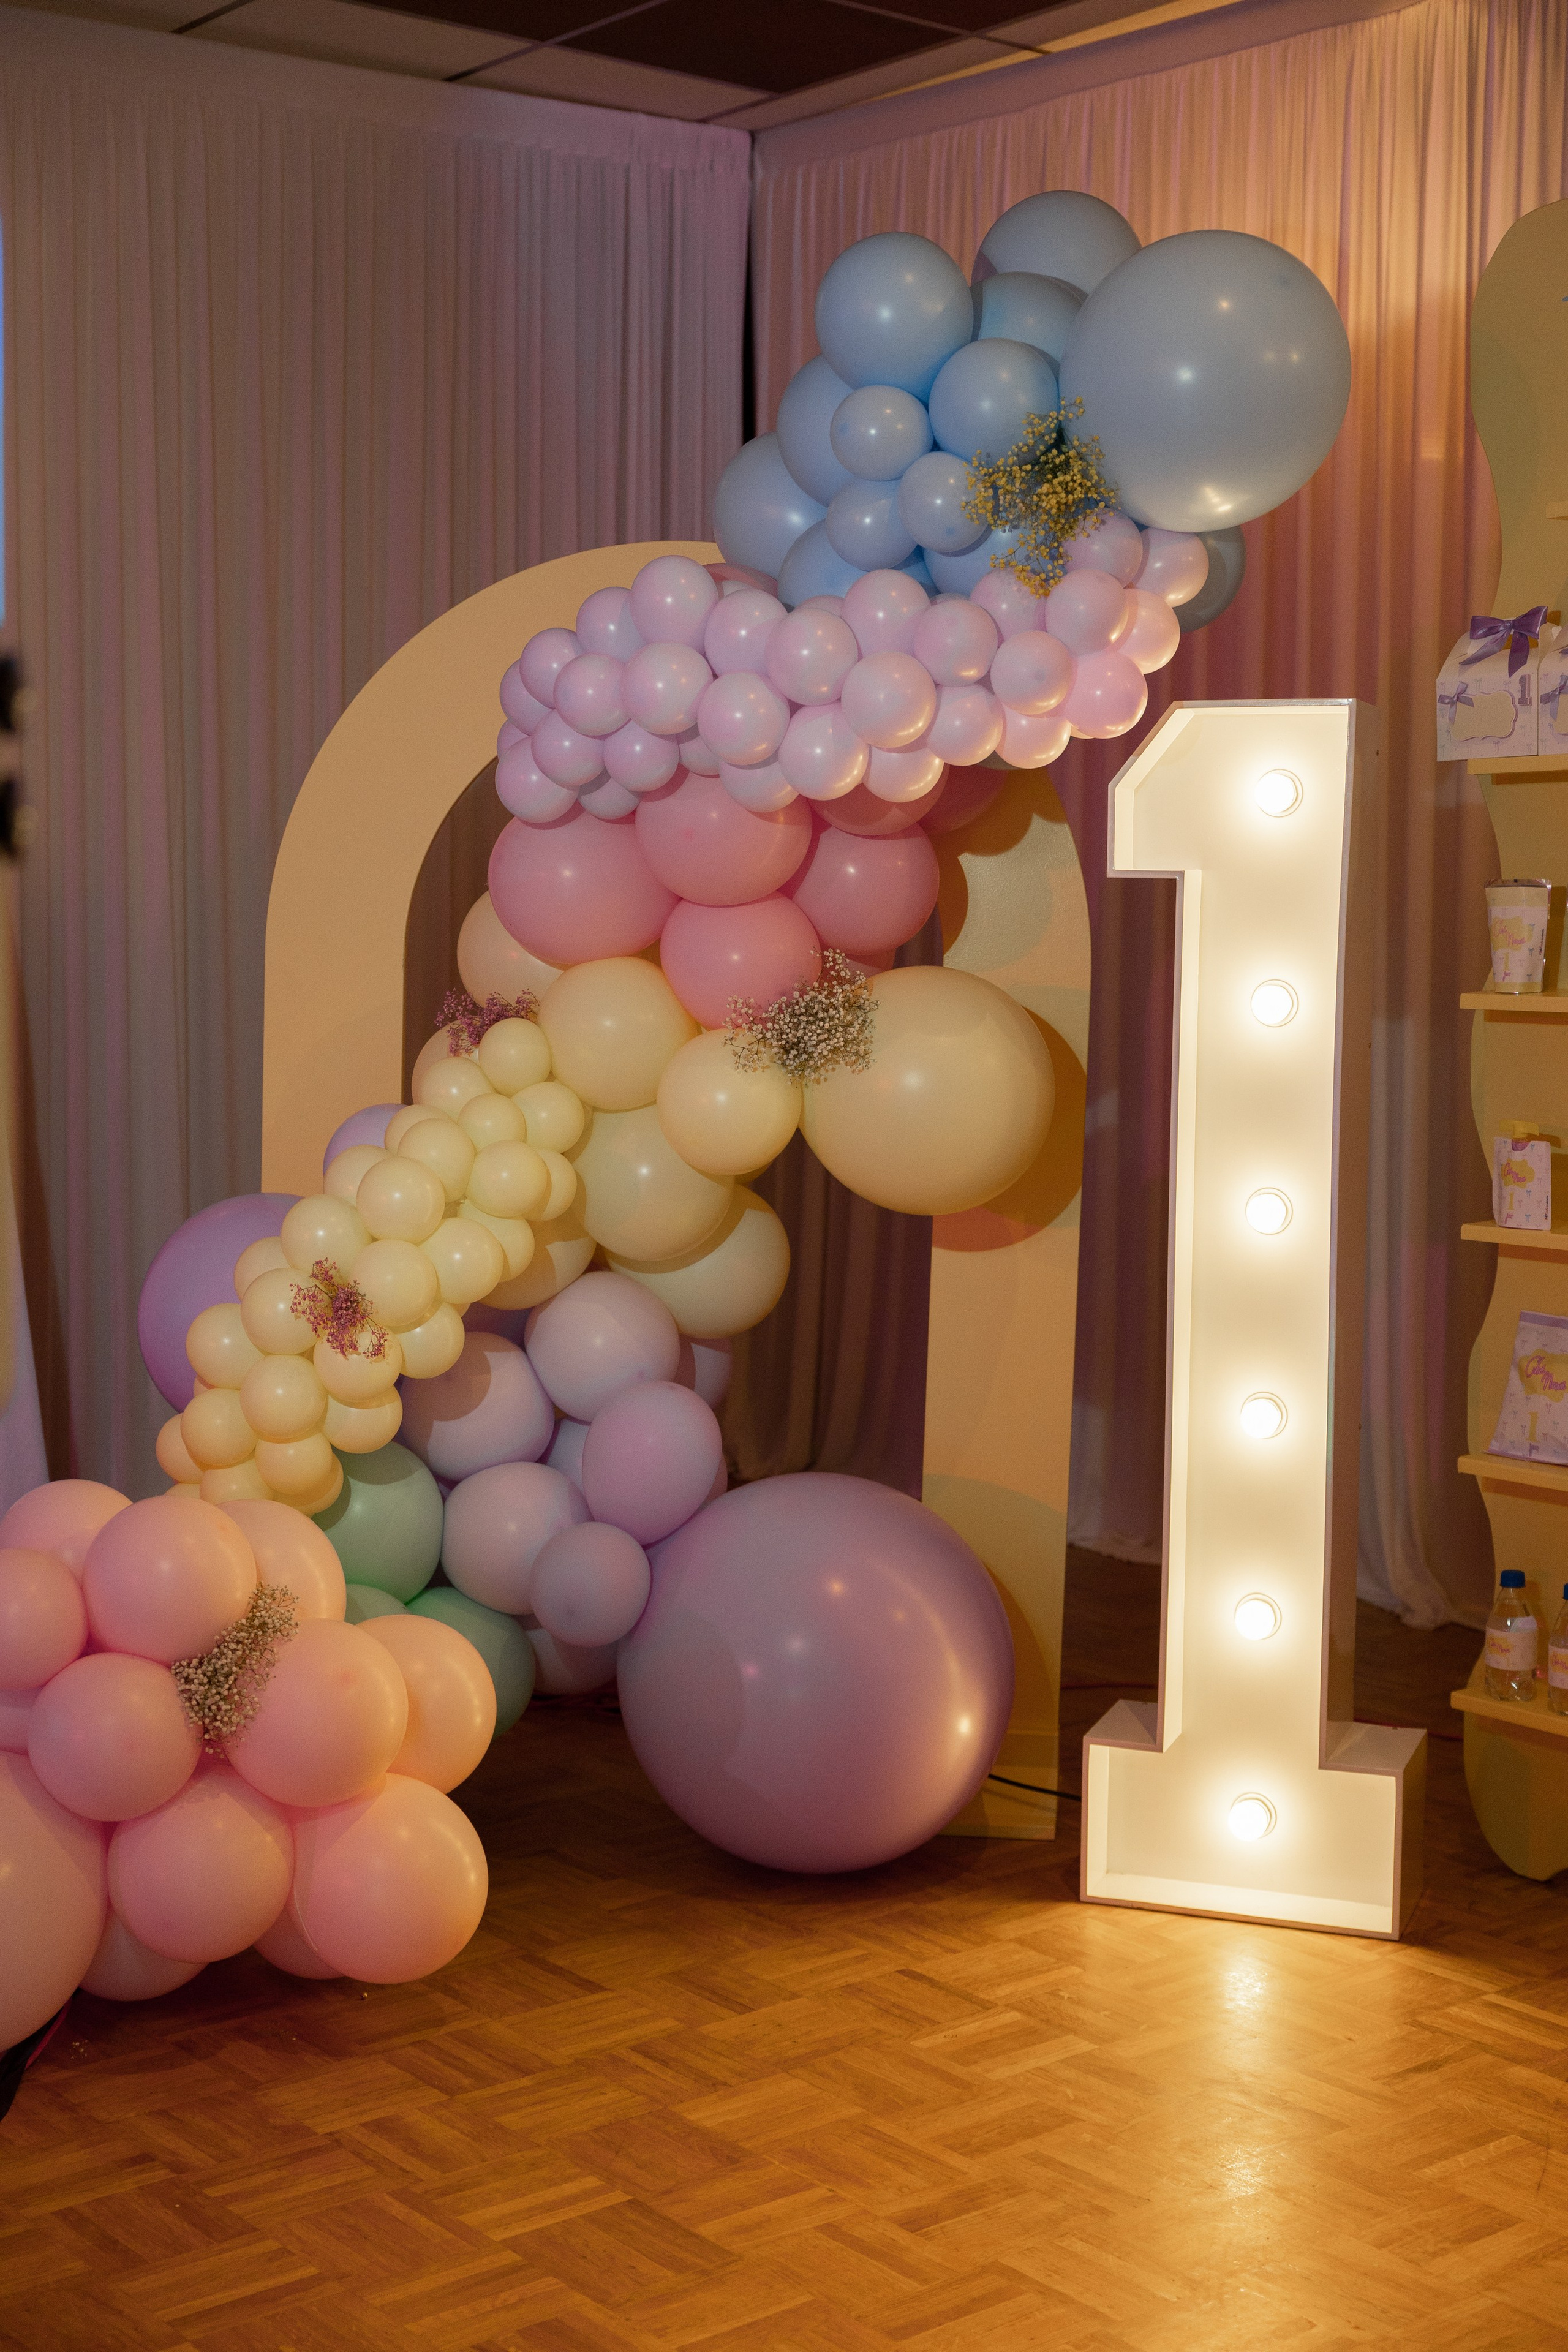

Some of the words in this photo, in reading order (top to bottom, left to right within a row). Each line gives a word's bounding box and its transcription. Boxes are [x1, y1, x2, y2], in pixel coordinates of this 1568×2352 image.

[1518, 673, 1533, 706] 1
[1082, 699, 1426, 1939] 1
[1525, 1411, 1540, 1443] 1
